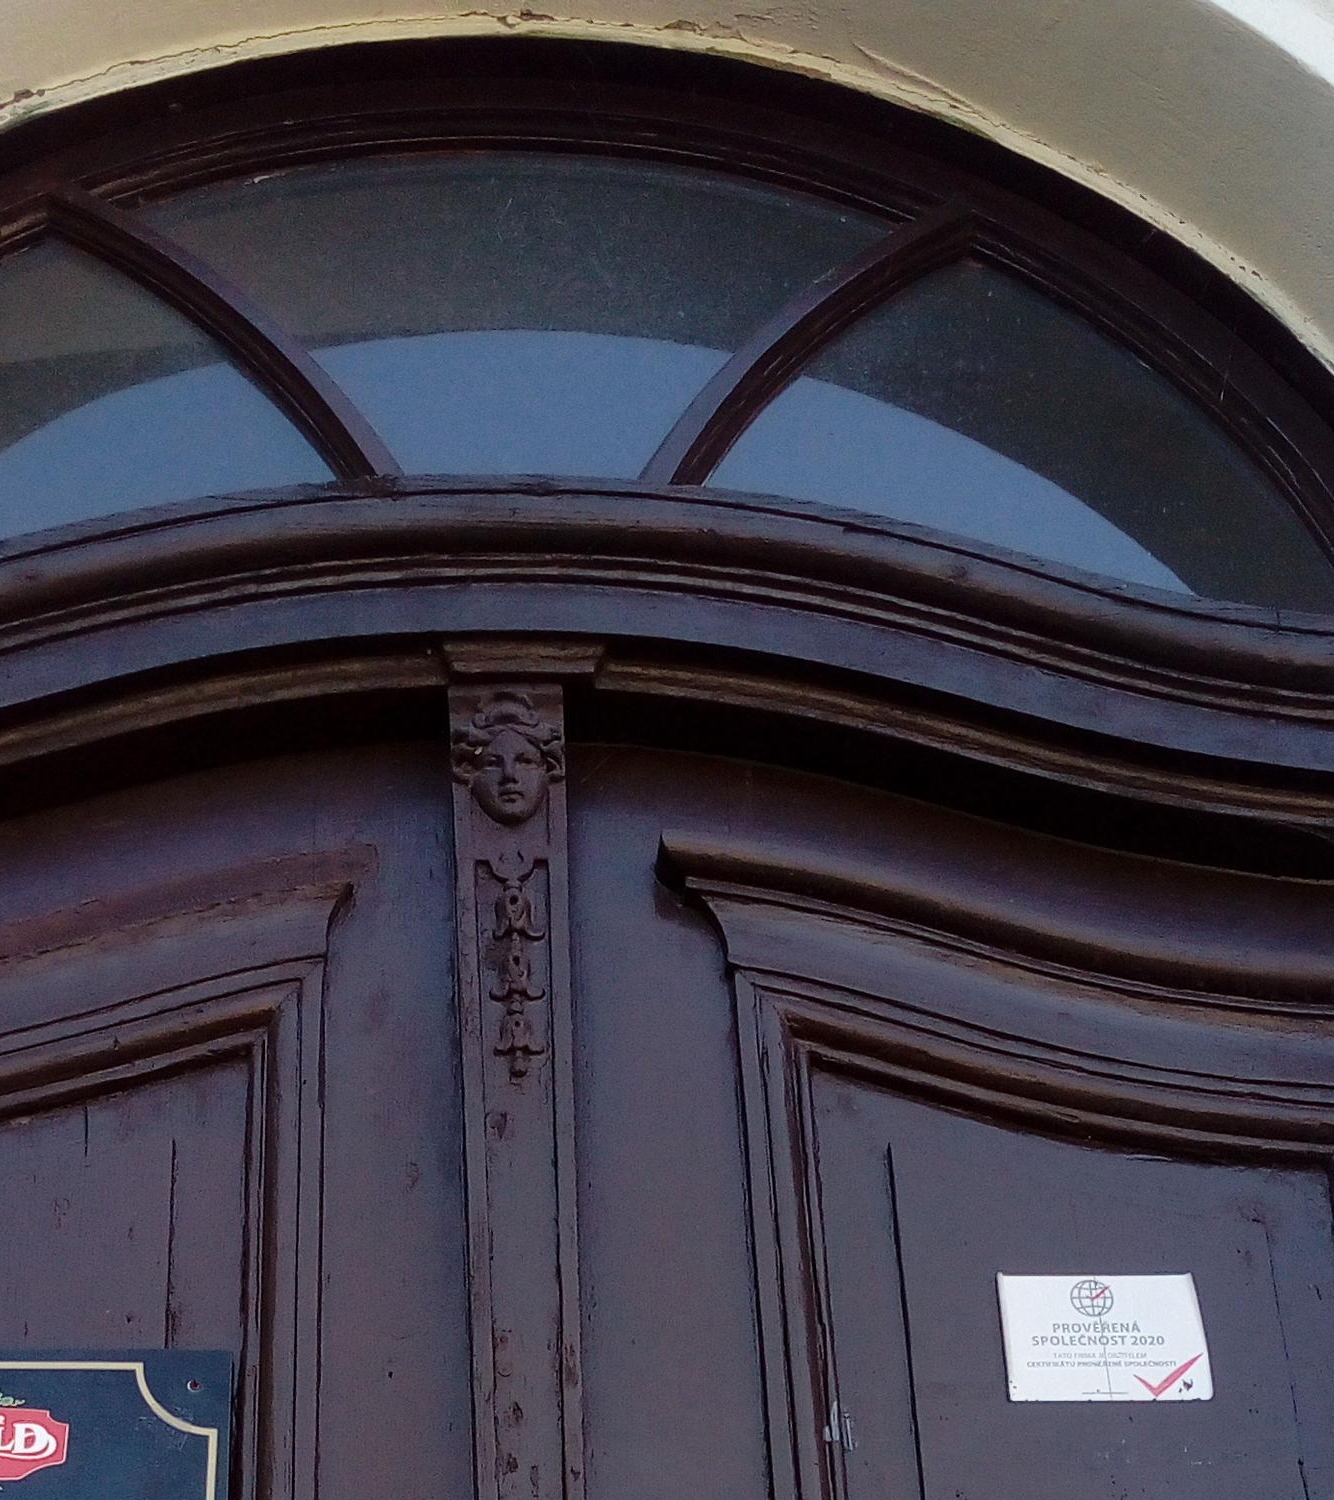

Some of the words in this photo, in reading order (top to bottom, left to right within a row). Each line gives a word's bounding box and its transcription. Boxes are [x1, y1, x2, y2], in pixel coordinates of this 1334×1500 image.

[1052, 1320, 1141, 1333] PROVĚŘENÁ
[1031, 1333, 1127, 1347] SPOLEČNOST
[1131, 1335, 1165, 1346] 2020
